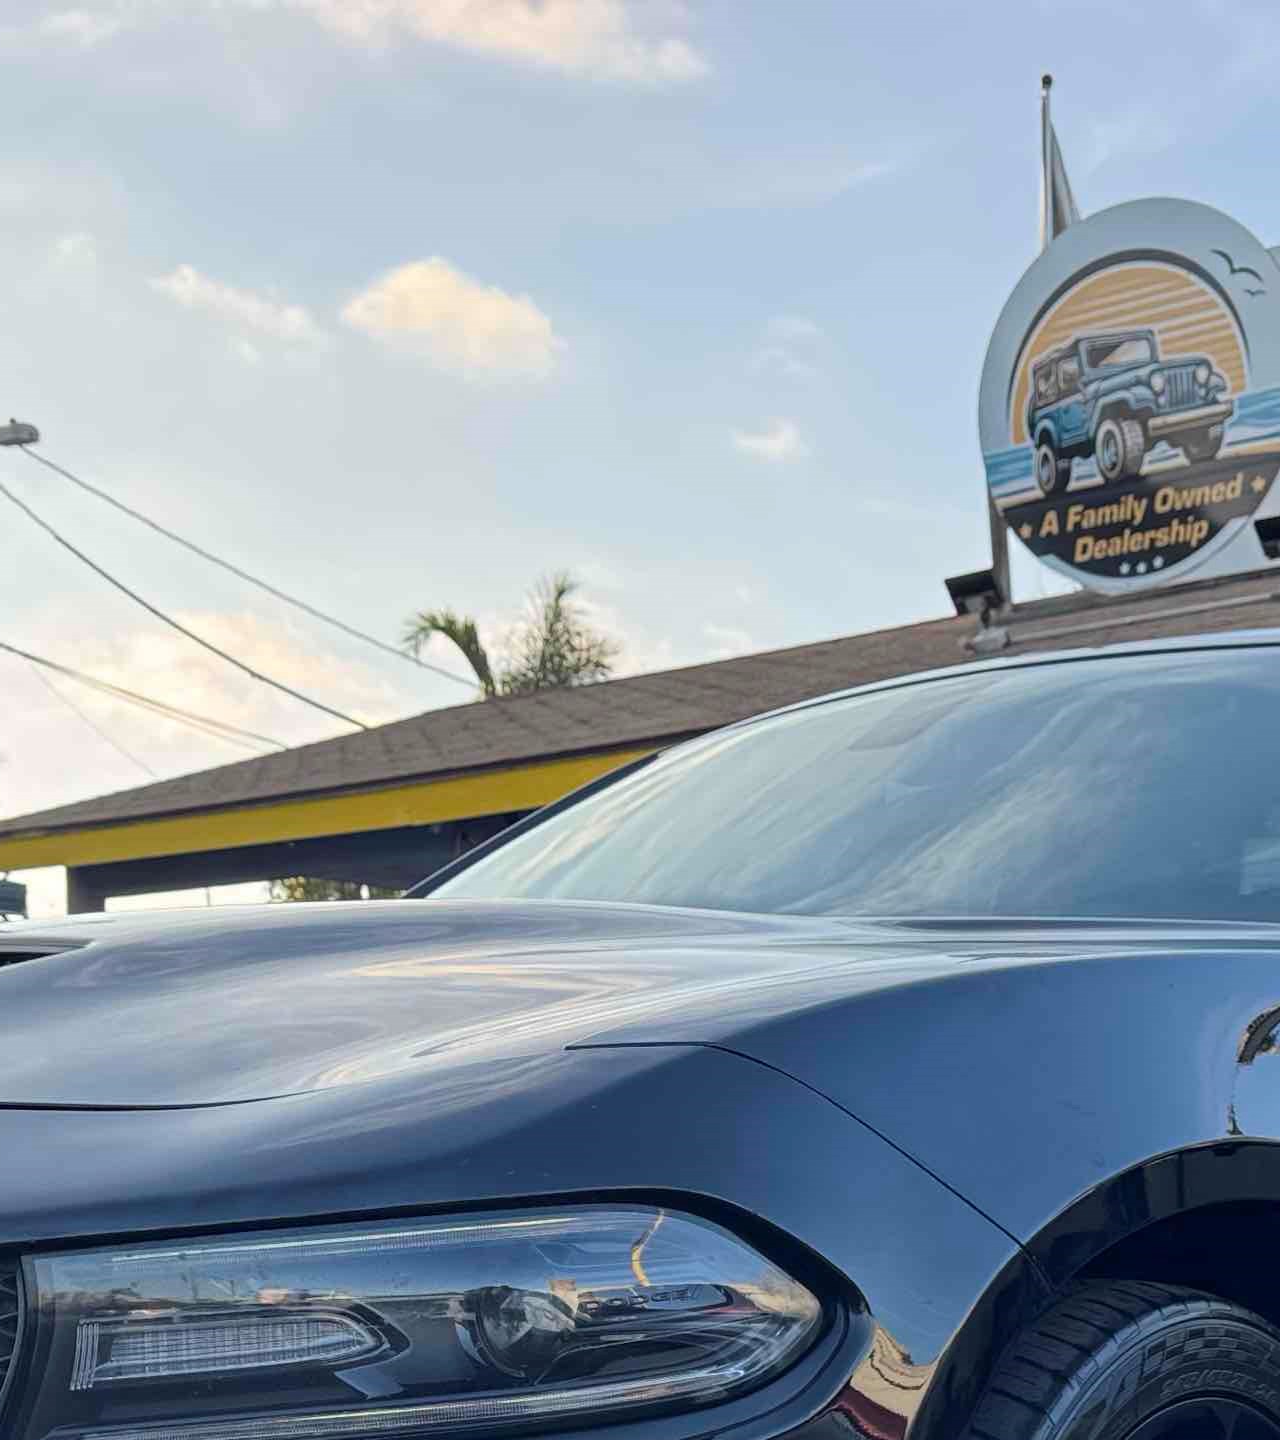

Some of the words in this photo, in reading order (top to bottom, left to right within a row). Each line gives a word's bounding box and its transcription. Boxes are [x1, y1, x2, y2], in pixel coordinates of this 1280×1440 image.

[1039, 509, 1060, 537] A
[1066, 493, 1147, 532] Family
[1153, 472, 1244, 515] Owned
[1073, 515, 1209, 563] Dealership
